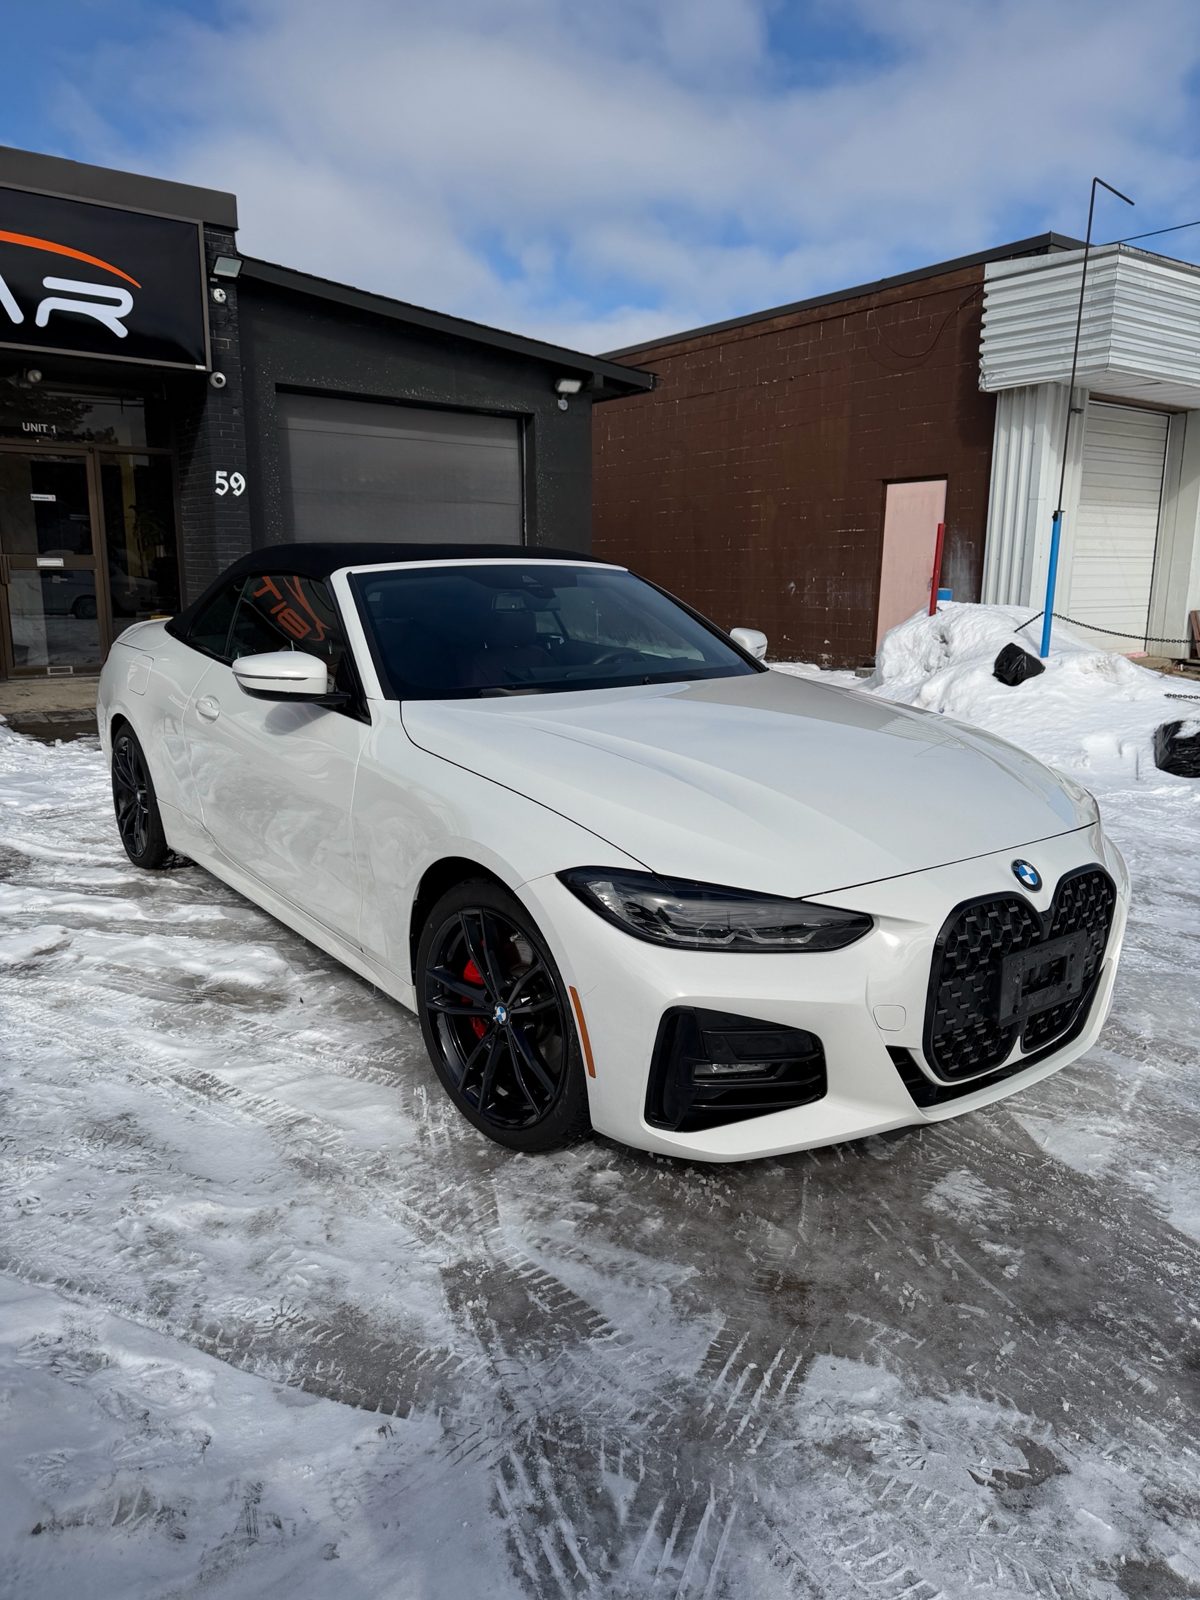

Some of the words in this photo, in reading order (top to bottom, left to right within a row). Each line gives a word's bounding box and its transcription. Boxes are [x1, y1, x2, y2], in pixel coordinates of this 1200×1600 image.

[22, 422, 48, 432] UNIT
[51, 425, 56, 434] 1
[214, 470, 246, 497] 59
